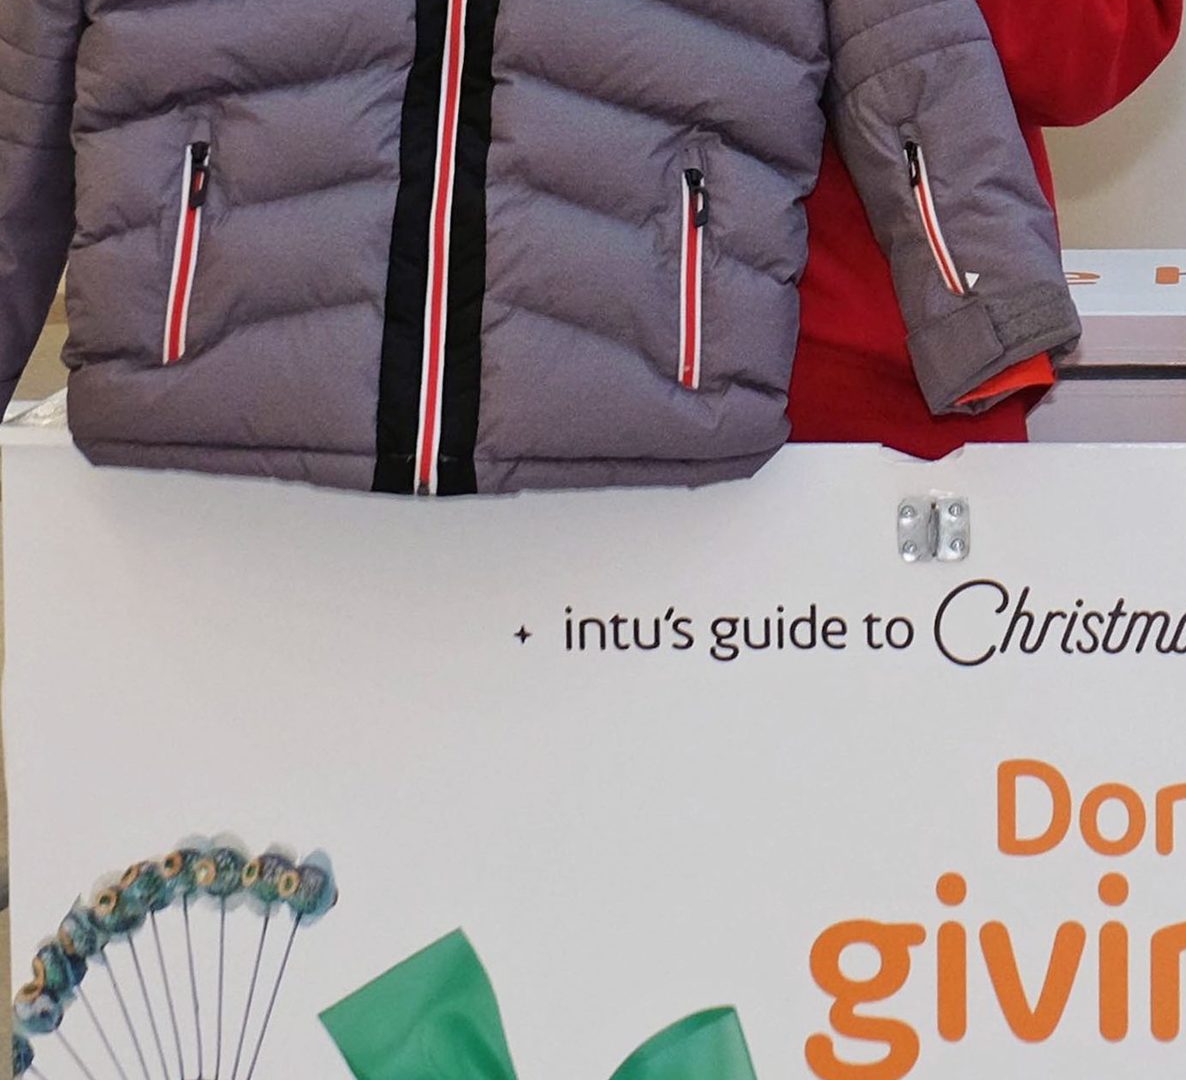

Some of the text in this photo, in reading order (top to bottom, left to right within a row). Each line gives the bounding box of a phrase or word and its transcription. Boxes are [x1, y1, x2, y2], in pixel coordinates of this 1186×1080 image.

[565, 606, 695, 651] intu's
[709, 603, 848, 662] guide
[862, 613, 915, 651] to
